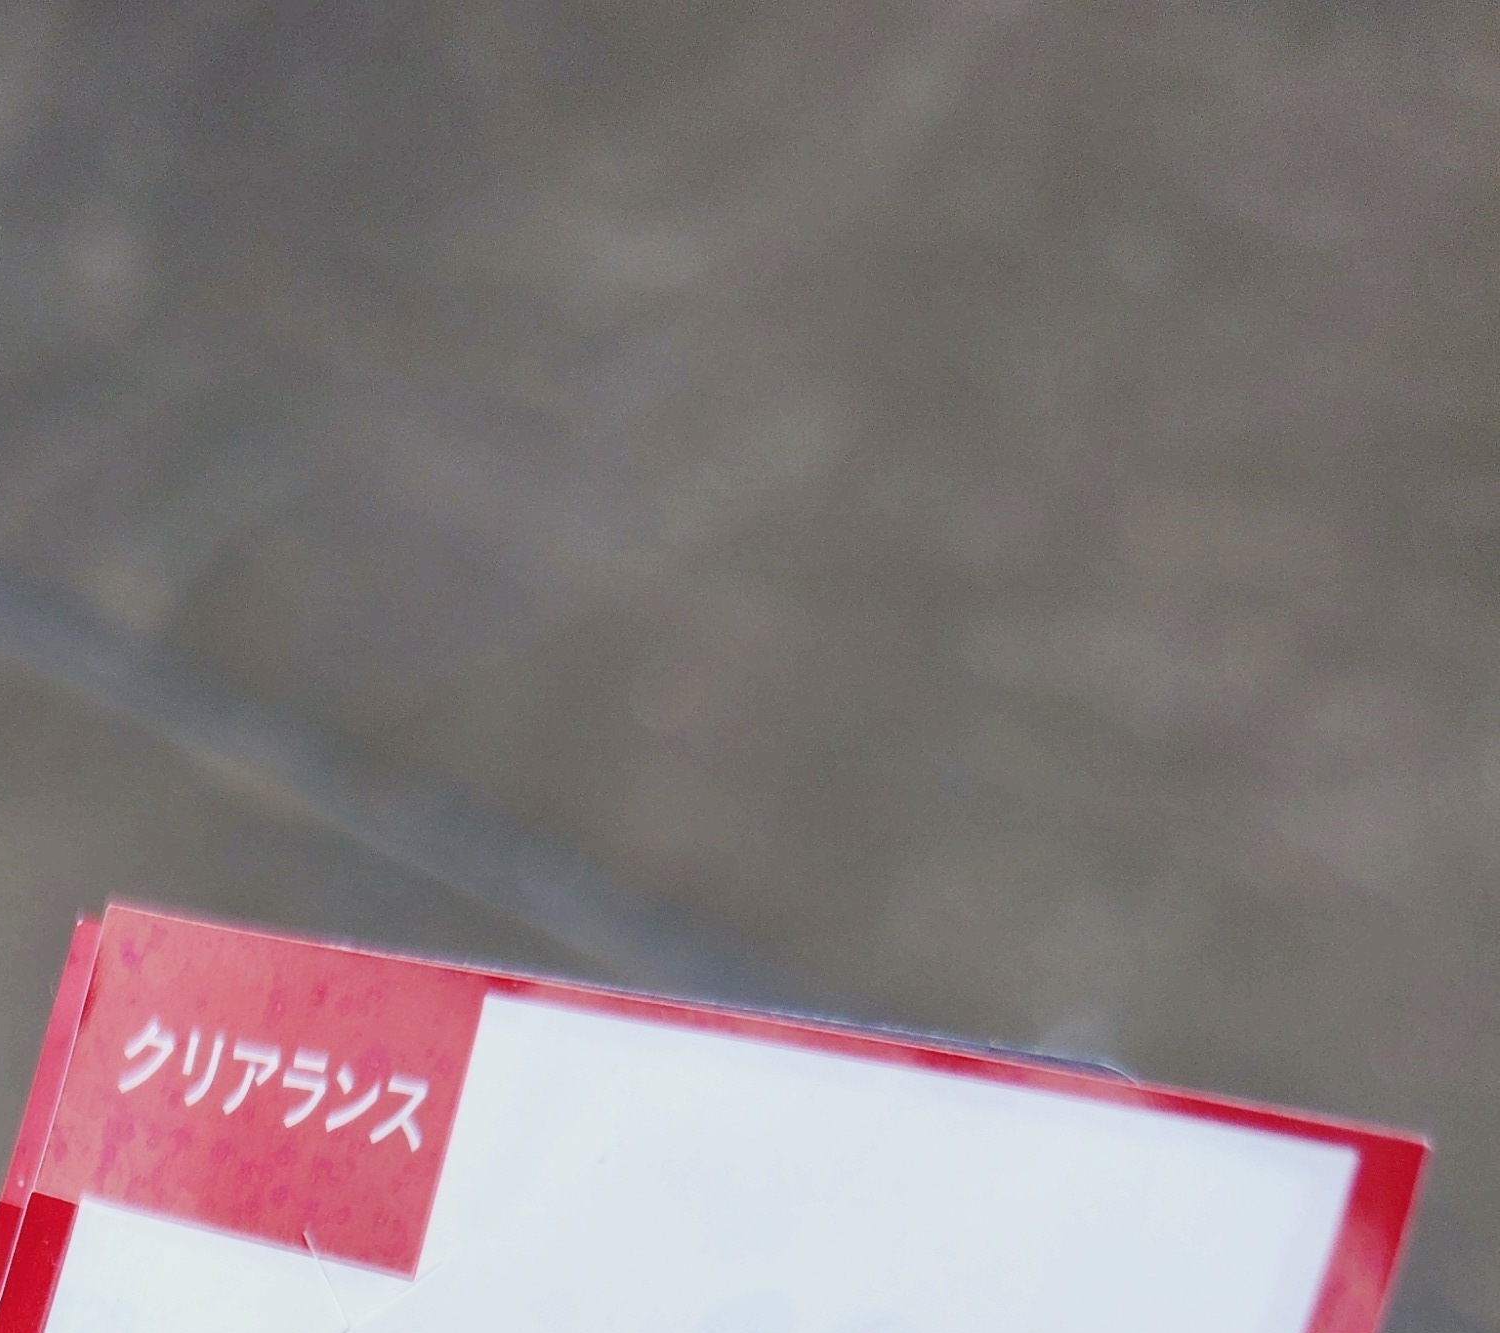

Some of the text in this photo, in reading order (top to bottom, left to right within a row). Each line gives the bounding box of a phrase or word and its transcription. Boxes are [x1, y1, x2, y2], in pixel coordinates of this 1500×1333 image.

[117, 1013, 429, 1152] クリアランス
